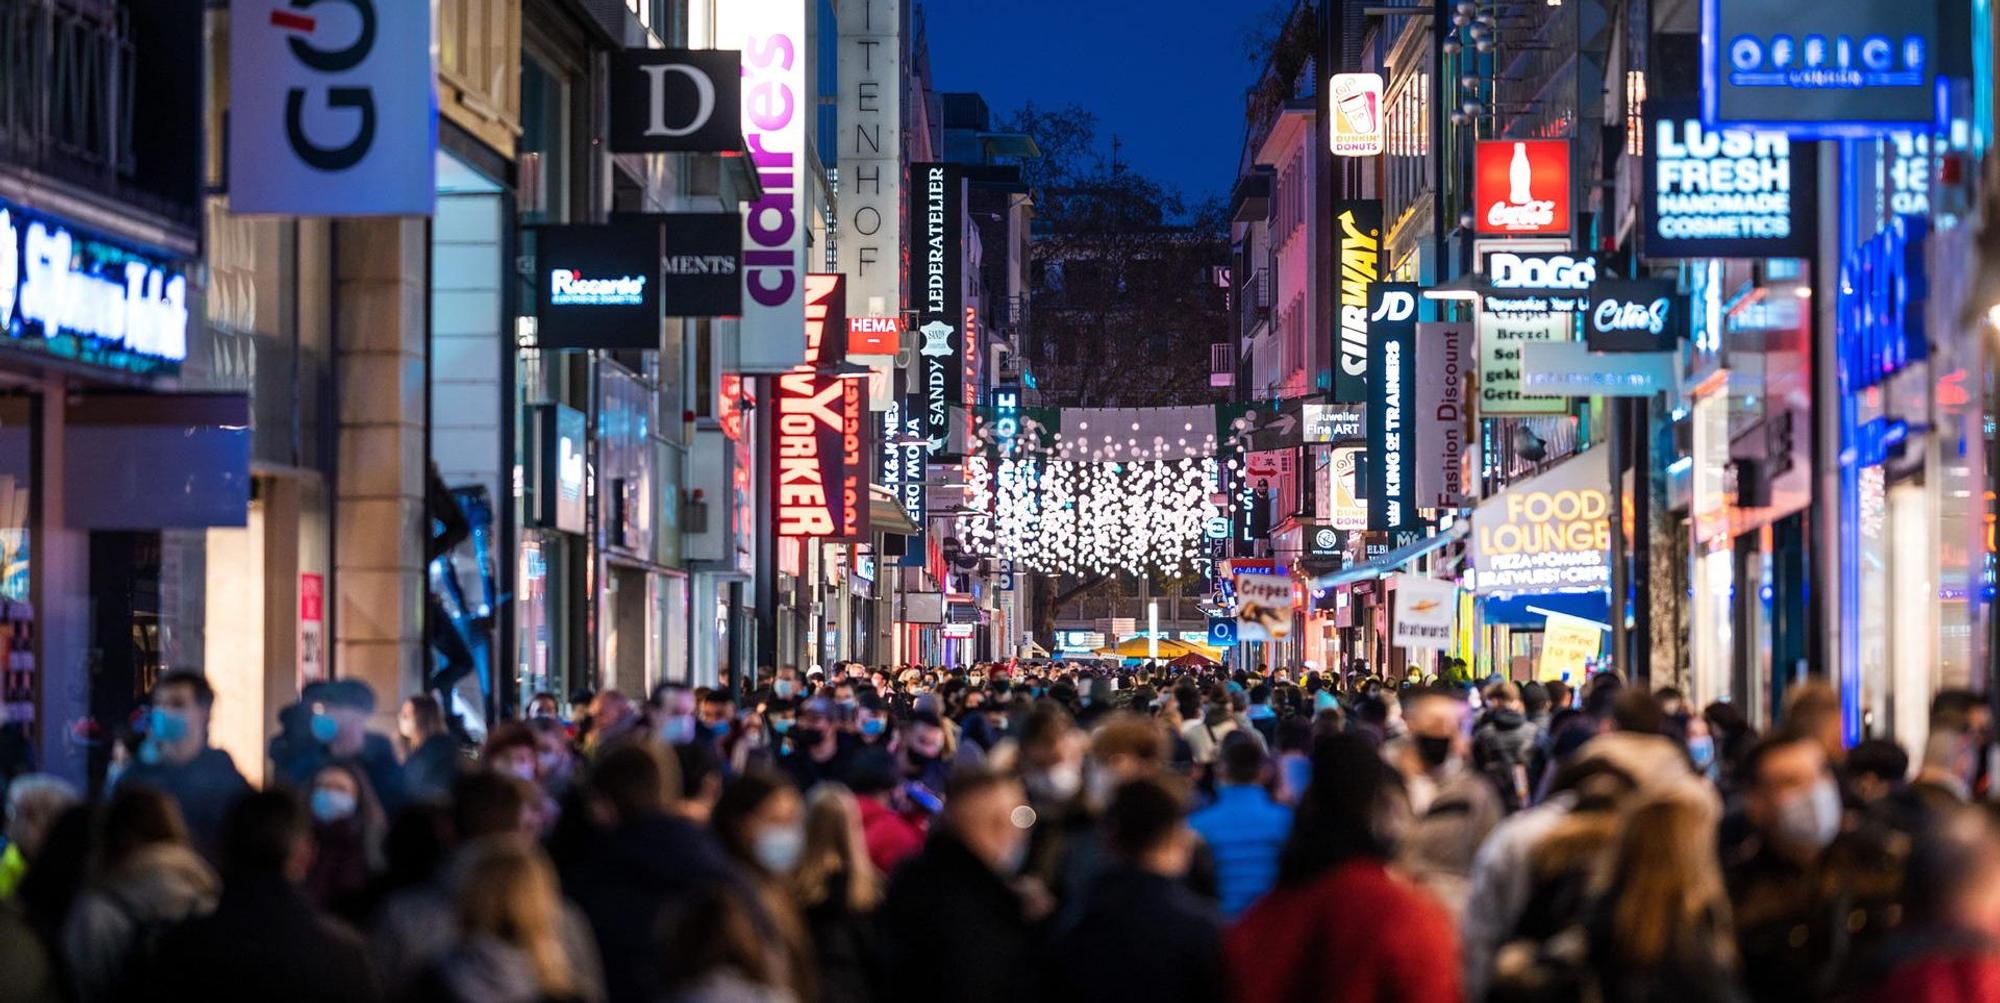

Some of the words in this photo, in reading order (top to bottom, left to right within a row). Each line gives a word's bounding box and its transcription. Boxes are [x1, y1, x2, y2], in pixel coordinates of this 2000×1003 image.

[1731, 37, 1924, 72] OFFICE
[1336, 143, 1378, 151] DONUTS
[1657, 158, 1790, 191] FRESH
[1657, 194, 1790, 215] HANDMADE
[929, 168, 943, 312] LEDERATELIER
[1657, 216, 1790, 239] COSMETICS
[1371, 291, 1414, 321] JD
[851, 318, 896, 333] HEMA
[929, 359, 944, 425] SANDY
[1386, 341, 1400, 431] TRAINERS
[1436, 331, 1458, 421] Discount
[1334, 424, 1360, 435] ART
[780, 379, 843, 535] YORKER
[1386, 452, 1400, 496] KING
[1437, 430, 1458, 508] Fashion
[1508, 489, 1606, 523] FOOD
[1480, 520, 1611, 555] LOUNGE
[1398, 621, 1450, 638] Bratwurst
